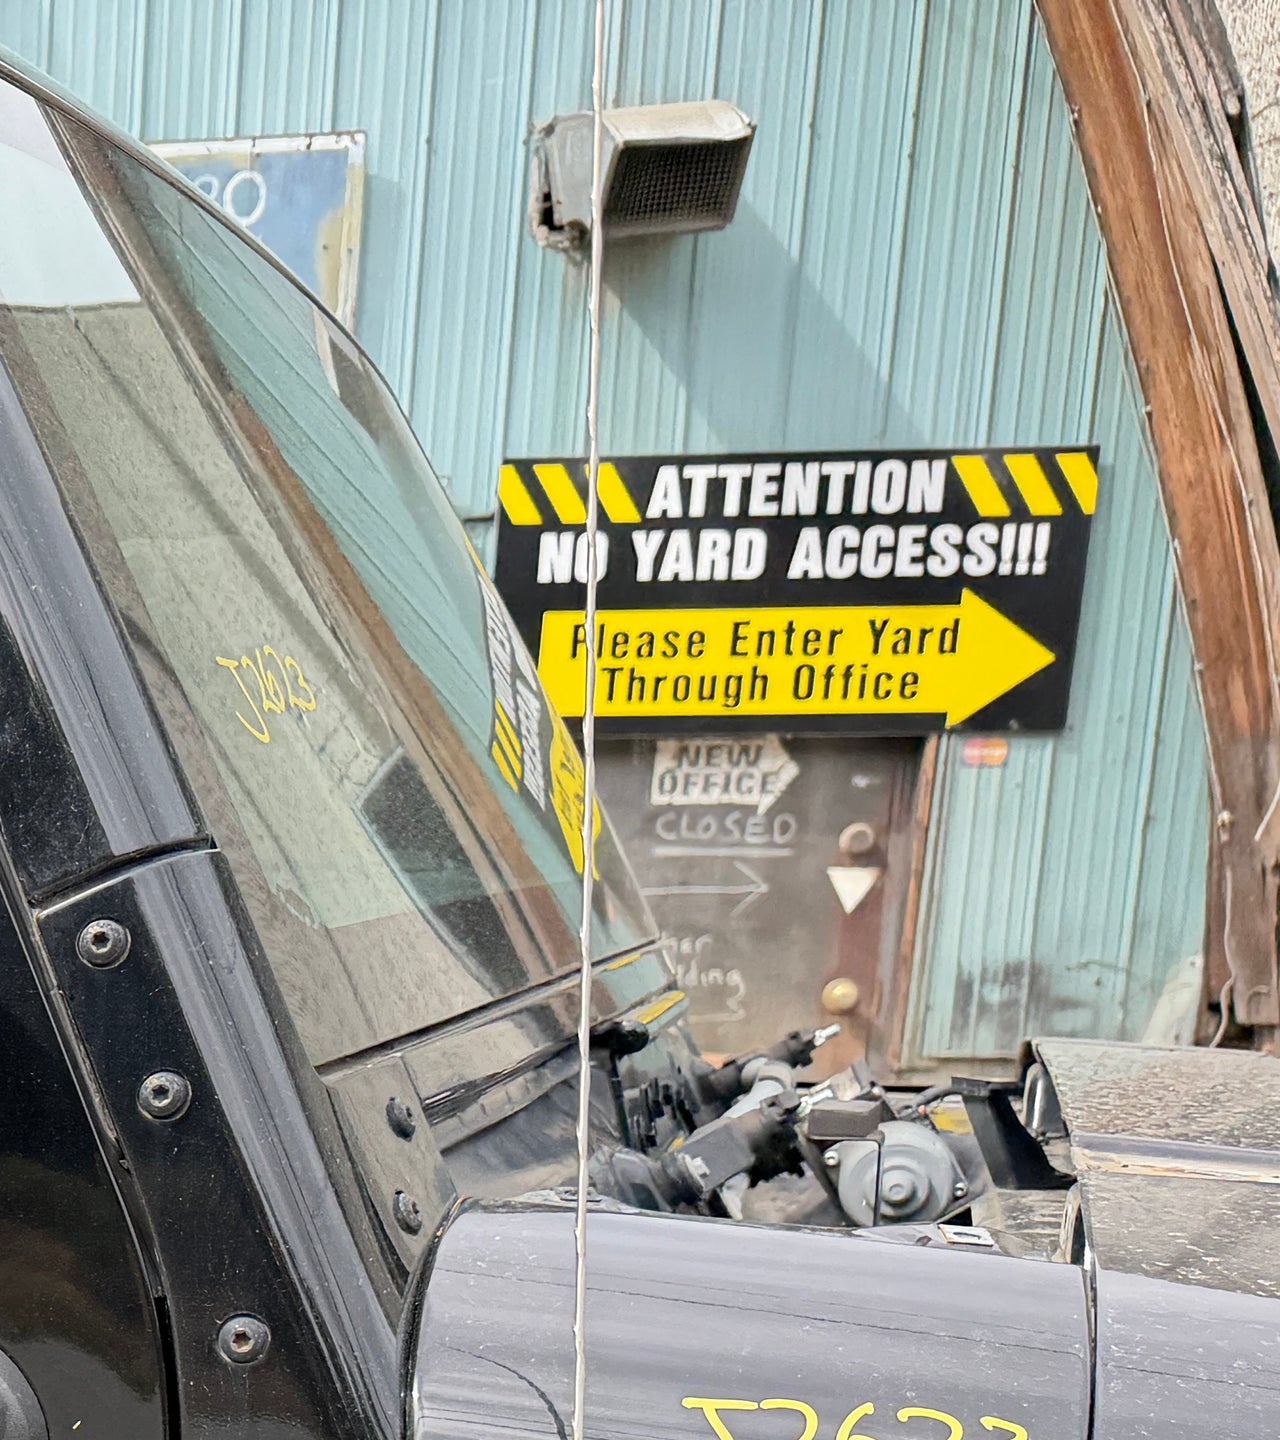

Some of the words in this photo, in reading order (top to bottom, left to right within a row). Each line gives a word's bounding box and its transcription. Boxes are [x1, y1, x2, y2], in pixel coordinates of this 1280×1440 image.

[646, 459, 947, 519] ATTENTION
[538, 530, 608, 584] NO
[632, 528, 767, 582] YARD
[787, 522, 1051, 580] ACCESS!!!
[573, 623, 705, 660] Please
[730, 619, 843, 658] Enter
[869, 618, 960, 655] Yard
[215, 645, 317, 743] J2623
[602, 666, 768, 708] Through
[793, 663, 920, 700] Office
[677, 743, 762, 768] NEW
[658, 768, 780, 796] OFFICE
[655, 810, 797, 844] CLOSED
